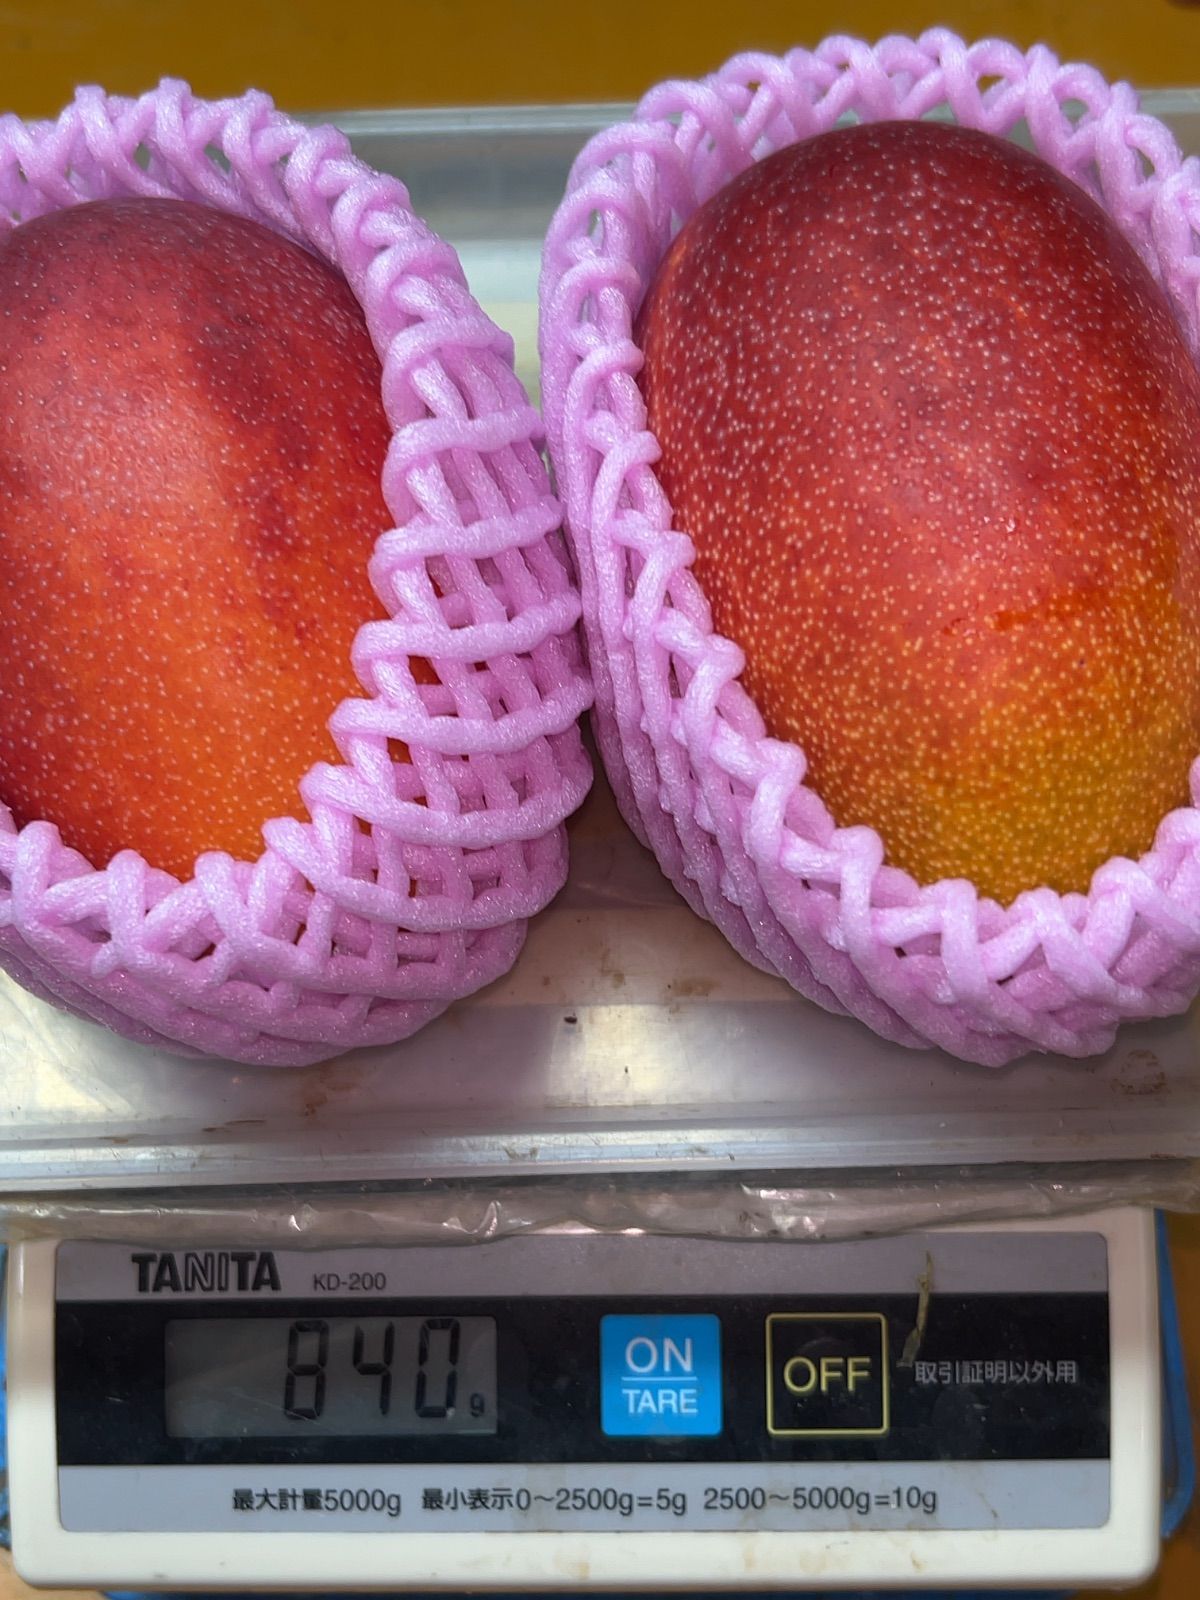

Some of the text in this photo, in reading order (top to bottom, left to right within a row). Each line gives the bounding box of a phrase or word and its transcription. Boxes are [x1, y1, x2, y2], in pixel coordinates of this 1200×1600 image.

[131, 1251, 281, 1292] TANITA
[313, 1272, 387, 1291] KD-200
[282, 1318, 461, 1419] 840
[624, 1337, 694, 1376] ON
[914, 1360, 1078, 1384] 取引証明以外用
[783, 1356, 871, 1395] OFF
[622, 1389, 699, 1416] TARE
[232, 1488, 402, 1516] 最大計量5000g
